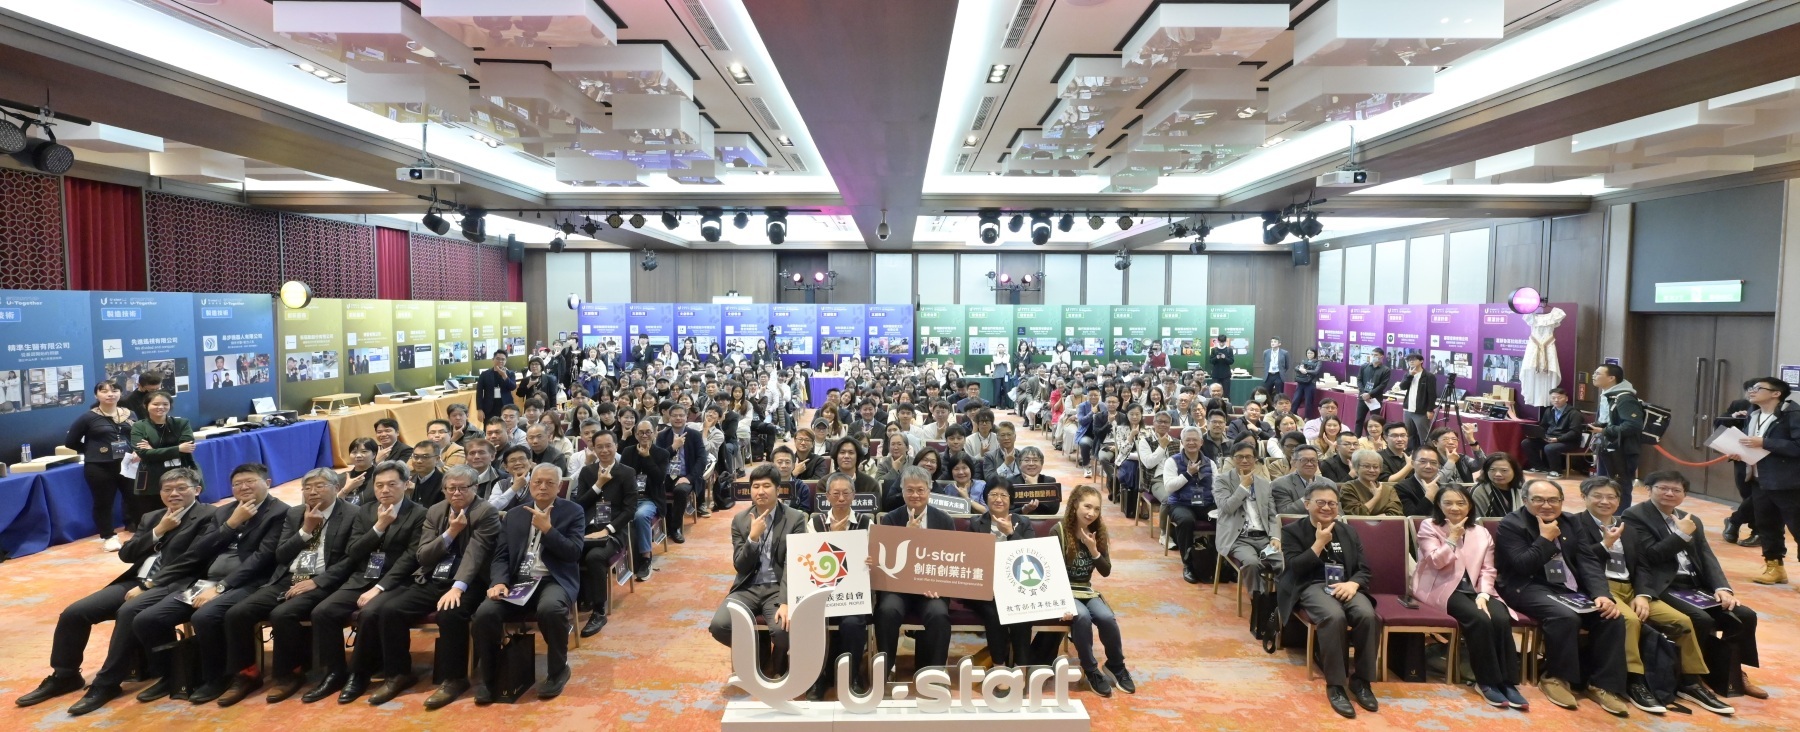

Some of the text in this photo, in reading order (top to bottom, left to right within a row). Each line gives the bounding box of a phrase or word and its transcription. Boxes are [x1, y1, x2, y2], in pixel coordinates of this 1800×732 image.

[915, 546, 966, 563] U-start
[914, 562, 984, 581] 創新創業計畫
[836, 651, 1083, 713] U-start
